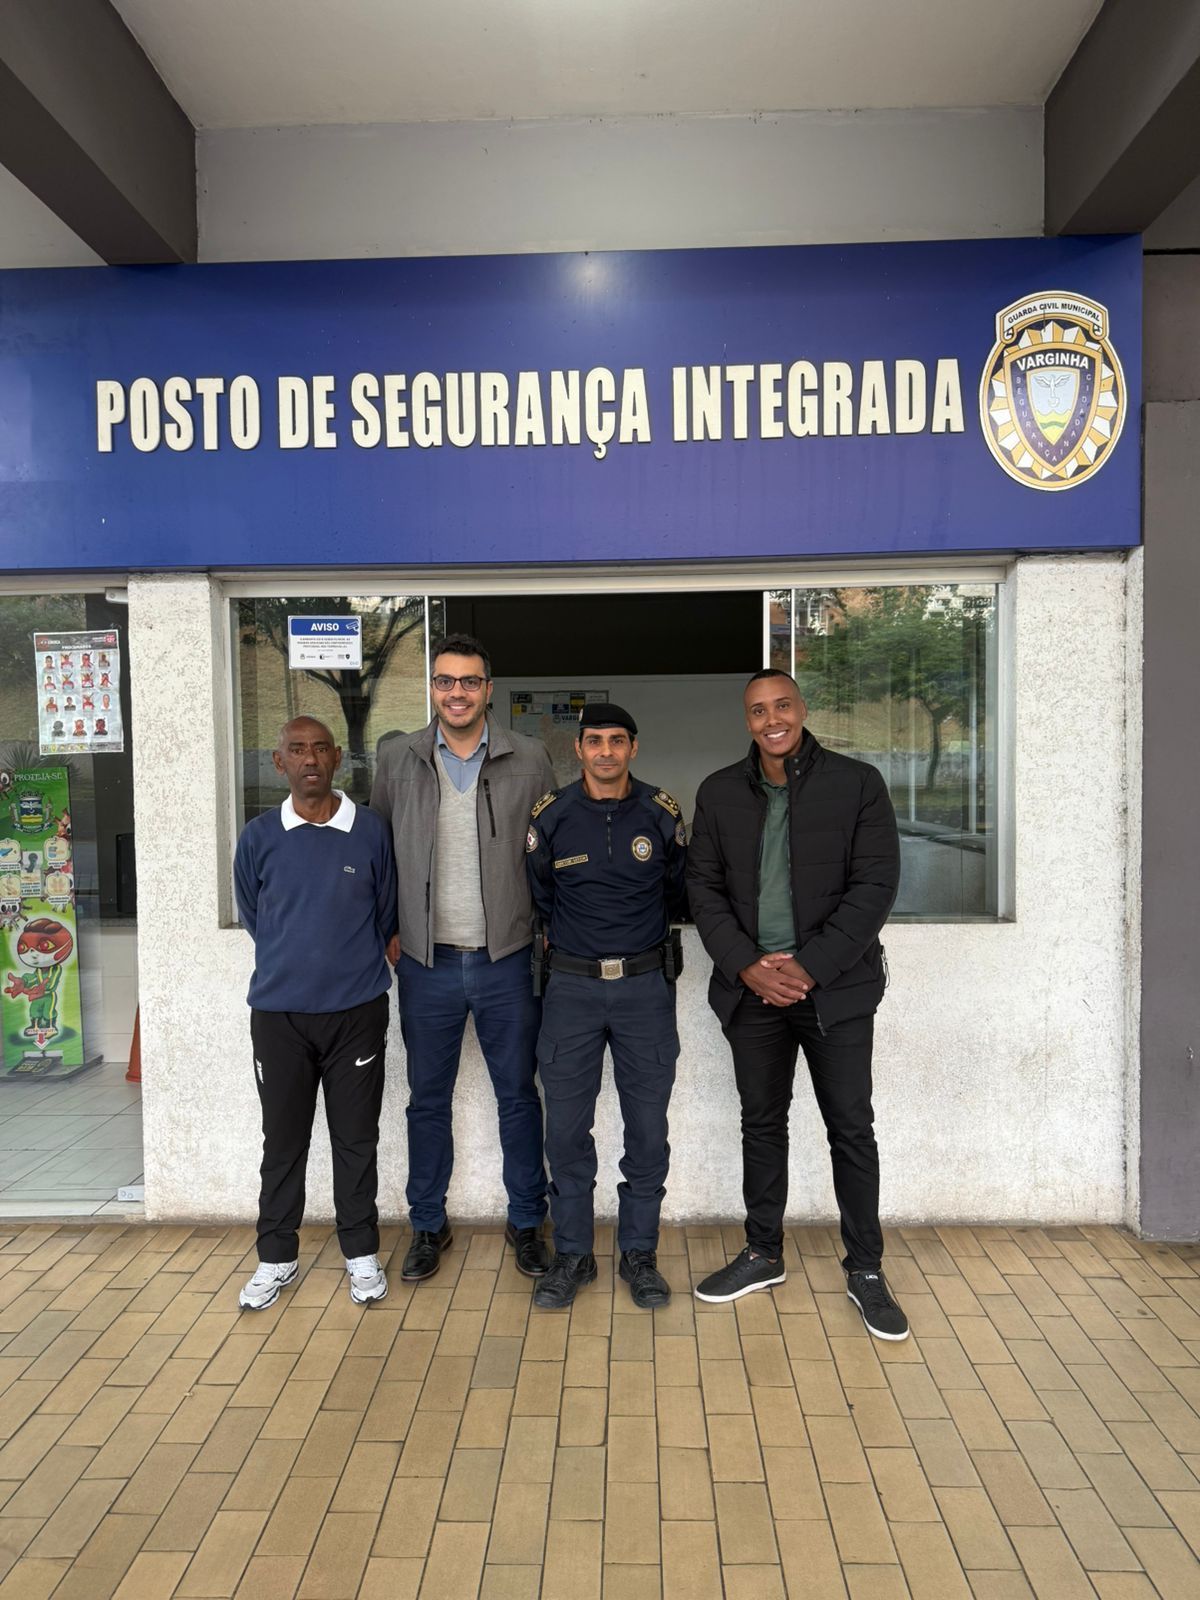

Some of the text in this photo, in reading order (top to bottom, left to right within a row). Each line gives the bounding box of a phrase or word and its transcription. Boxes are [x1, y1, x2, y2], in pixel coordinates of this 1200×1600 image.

[1008, 302, 1100, 323] GUARDA CIVIL MUNICIPAL
[1016, 352, 1089, 371] VARGINHA
[97, 359, 965, 460] POSTO DE SEGURANÇA INTEGRADA
[311, 623, 339, 632] AVISO
